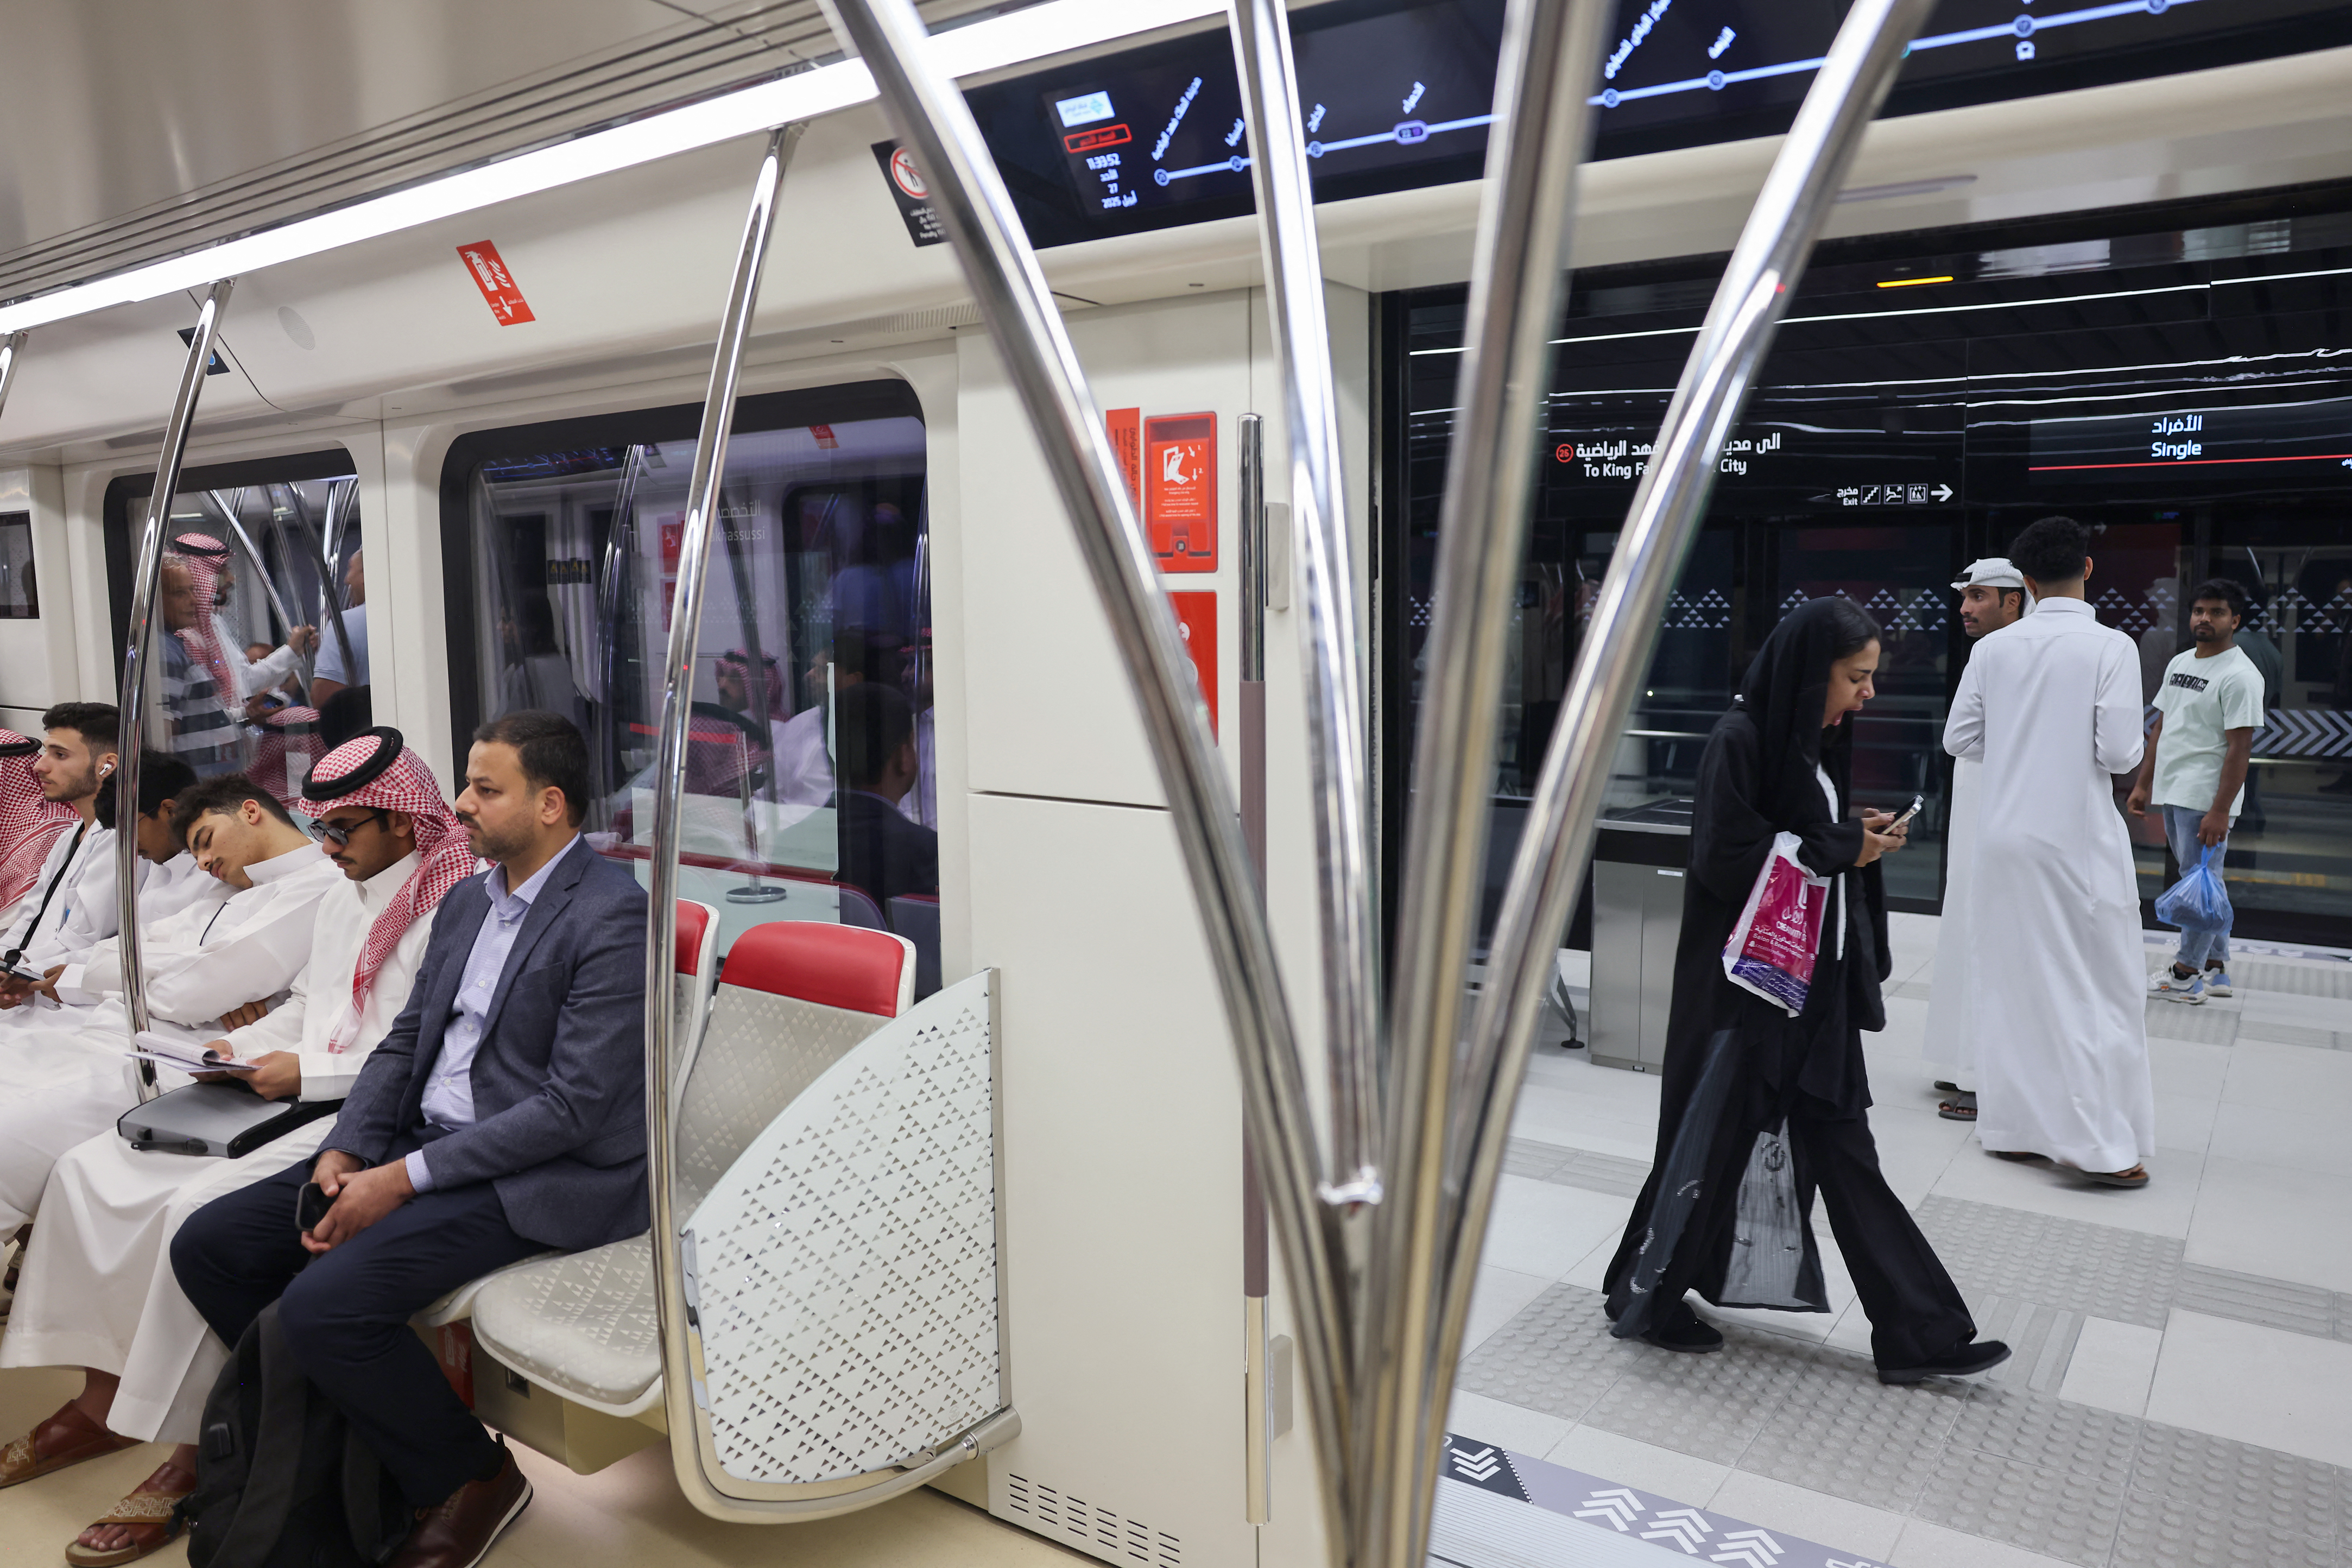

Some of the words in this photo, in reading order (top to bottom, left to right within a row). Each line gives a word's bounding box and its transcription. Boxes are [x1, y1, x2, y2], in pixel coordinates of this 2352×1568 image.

[2152, 415, 2202, 435] الأفراد
[1576, 440, 1627, 461] الرياضية
[2152, 440, 2202, 459] Single
[1583, 464, 1599, 477] To
[1603, 463, 1632, 479] King
[1720, 458, 1747, 475] City
[1837, 486, 1858, 498] مخرج
[716, 499, 760, 519] التخصص
[1843, 497, 1858, 505] Exit
[710, 526, 765, 542] akhassussi
[1753, 933, 1770, 943] Salon
